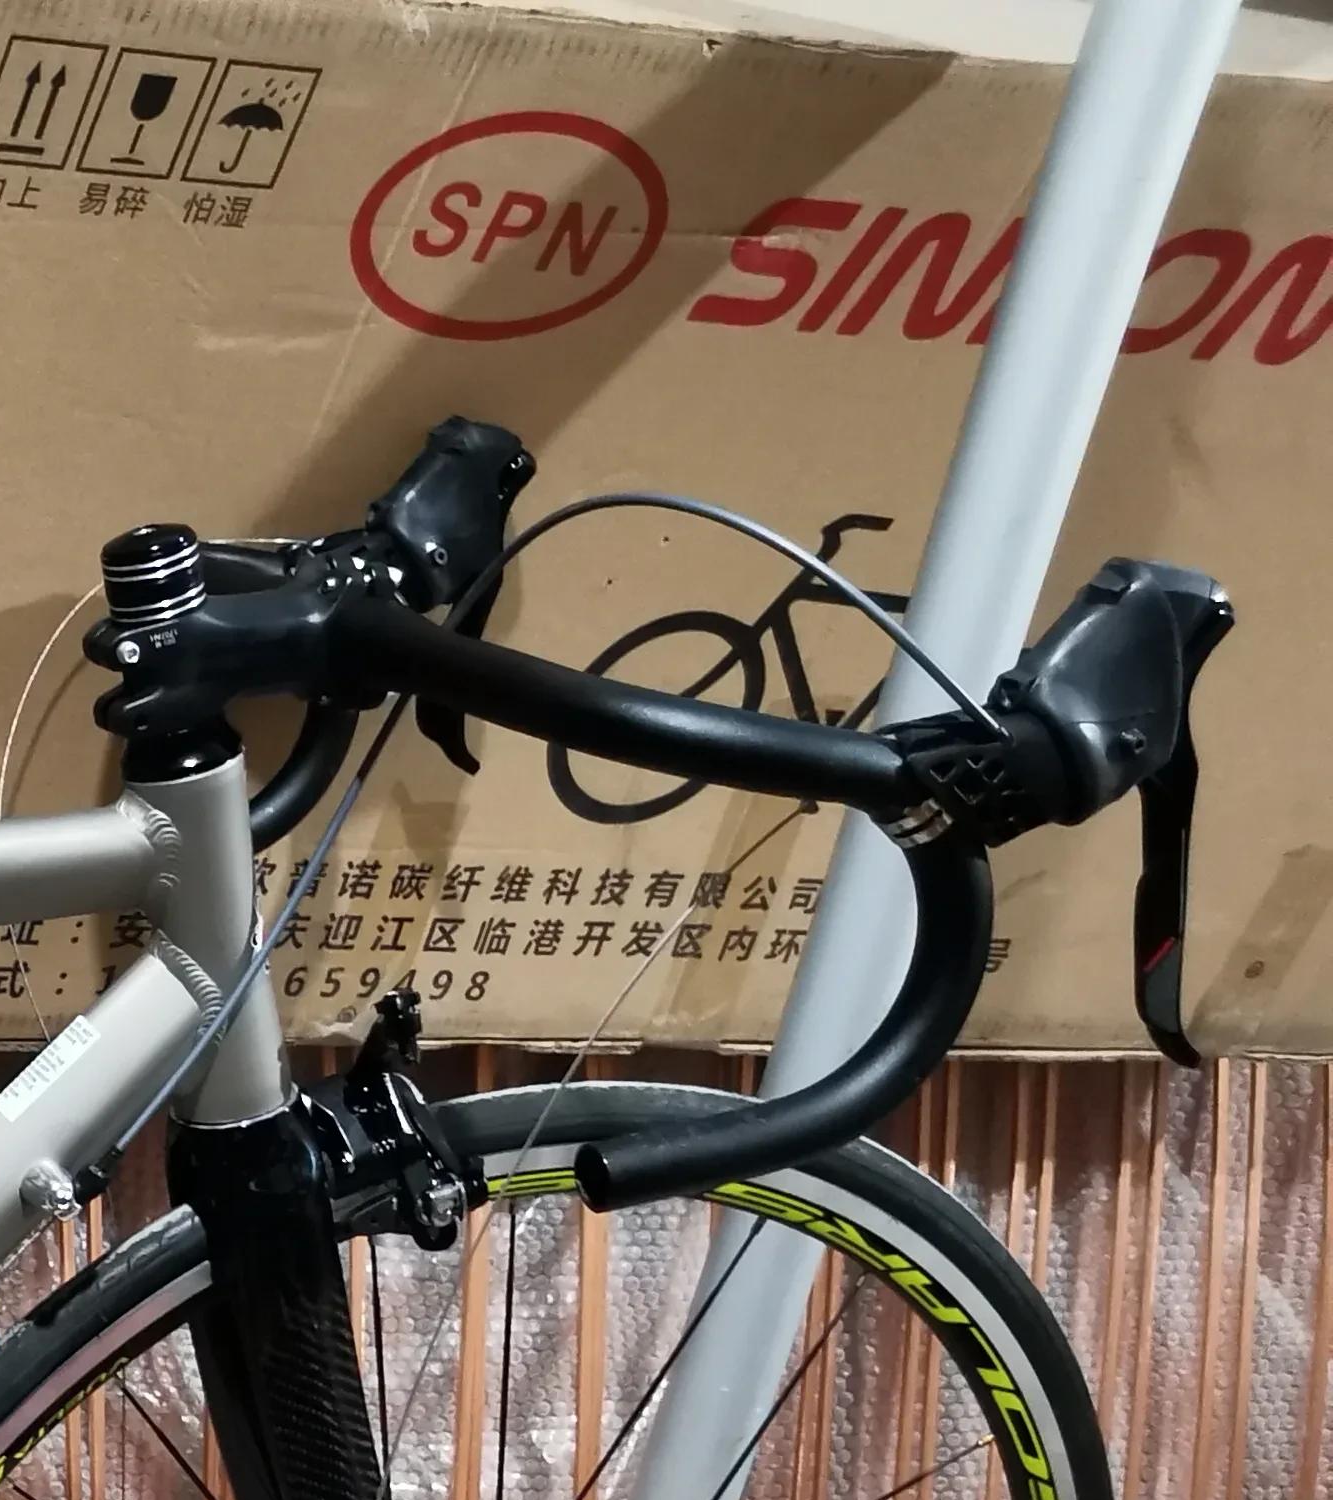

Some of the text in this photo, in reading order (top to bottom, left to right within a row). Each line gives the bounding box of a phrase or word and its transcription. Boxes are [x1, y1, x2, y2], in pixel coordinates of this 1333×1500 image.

[78, 184, 151, 219] 易碎
[182, 192, 256, 229] 怕湿
[411, 181, 618, 277] SPN
